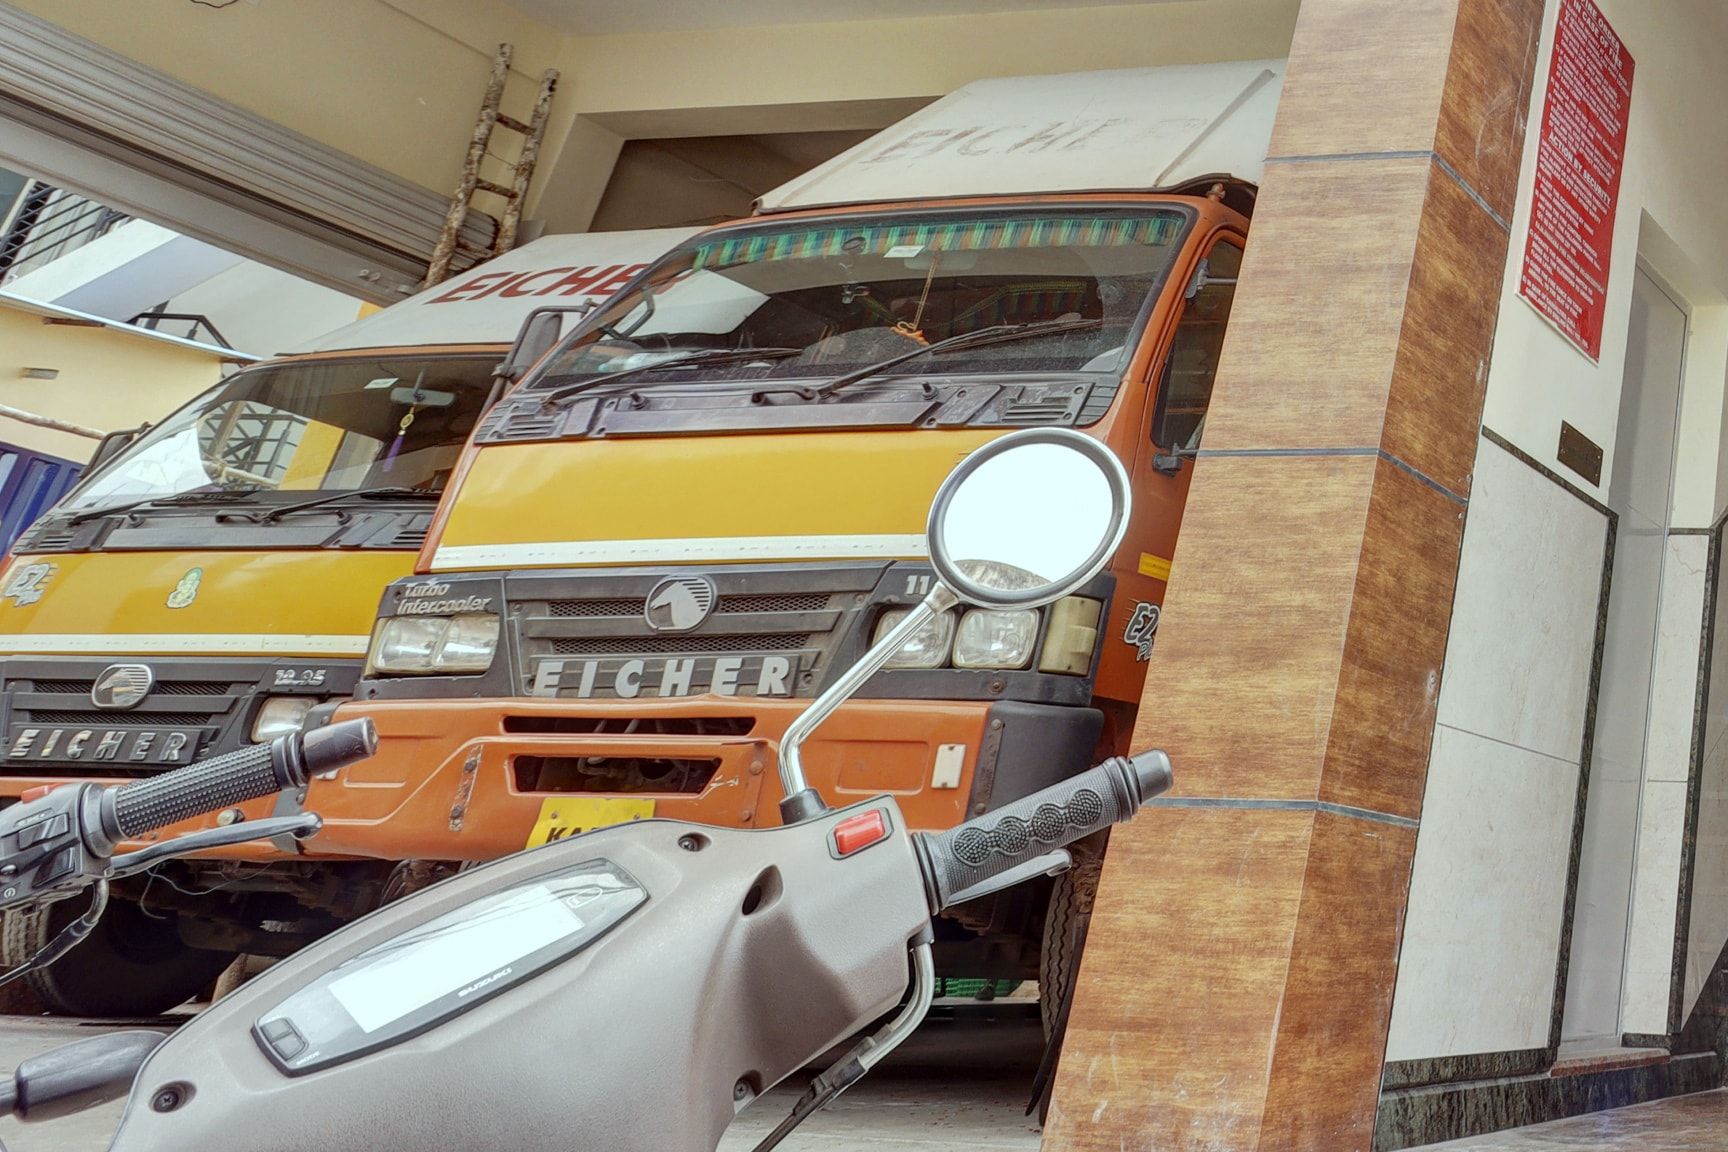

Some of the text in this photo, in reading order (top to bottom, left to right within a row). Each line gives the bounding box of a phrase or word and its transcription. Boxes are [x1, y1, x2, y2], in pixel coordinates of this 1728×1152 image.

[404, 578, 451, 597] Turbo
[397, 595, 492, 615] Intercooler
[532, 656, 793, 698] EICHER
[9, 728, 189, 761] EICHER
